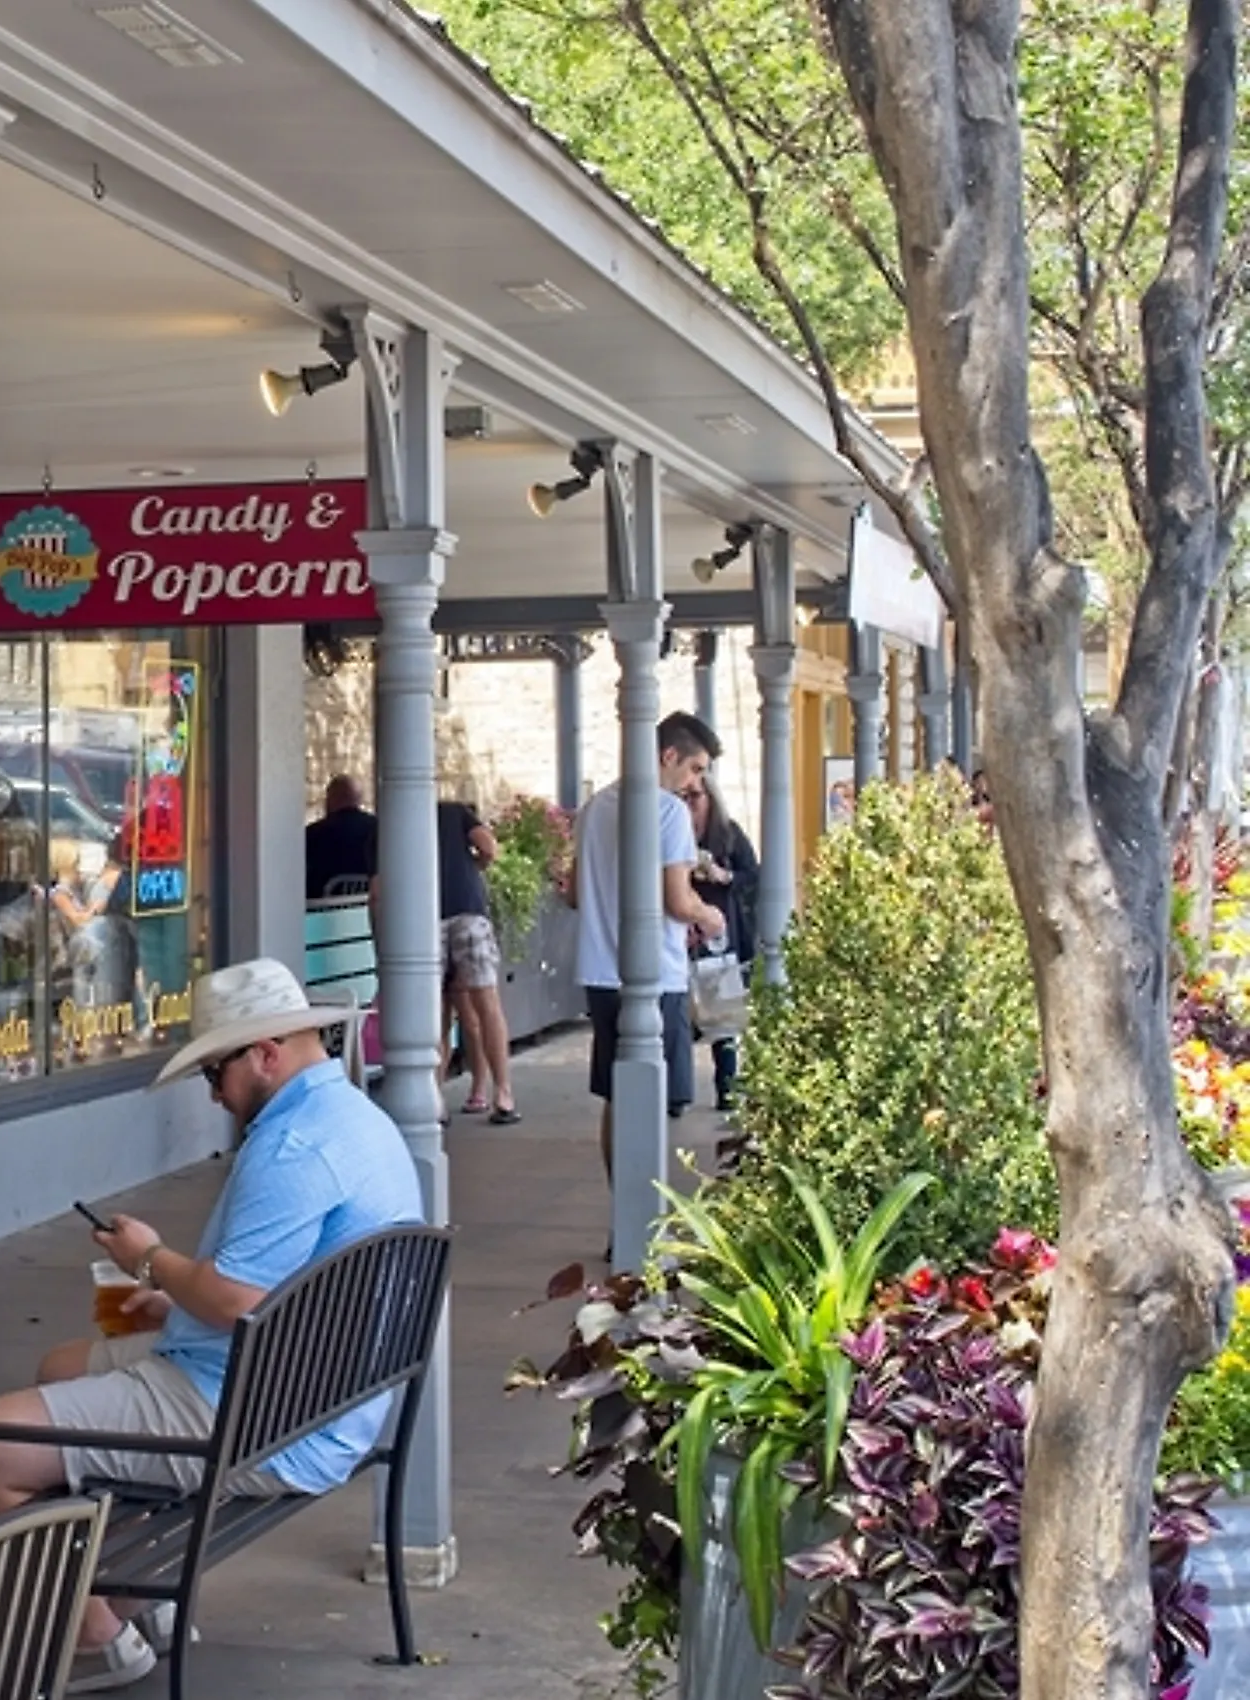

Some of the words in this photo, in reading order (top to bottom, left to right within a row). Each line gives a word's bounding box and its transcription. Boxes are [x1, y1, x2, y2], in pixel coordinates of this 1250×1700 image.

[130, 495, 293, 543] Candy
[305, 491, 345, 529] &
[106, 550, 370, 616] Popcorn
[138, 869, 182, 903] OPEN
